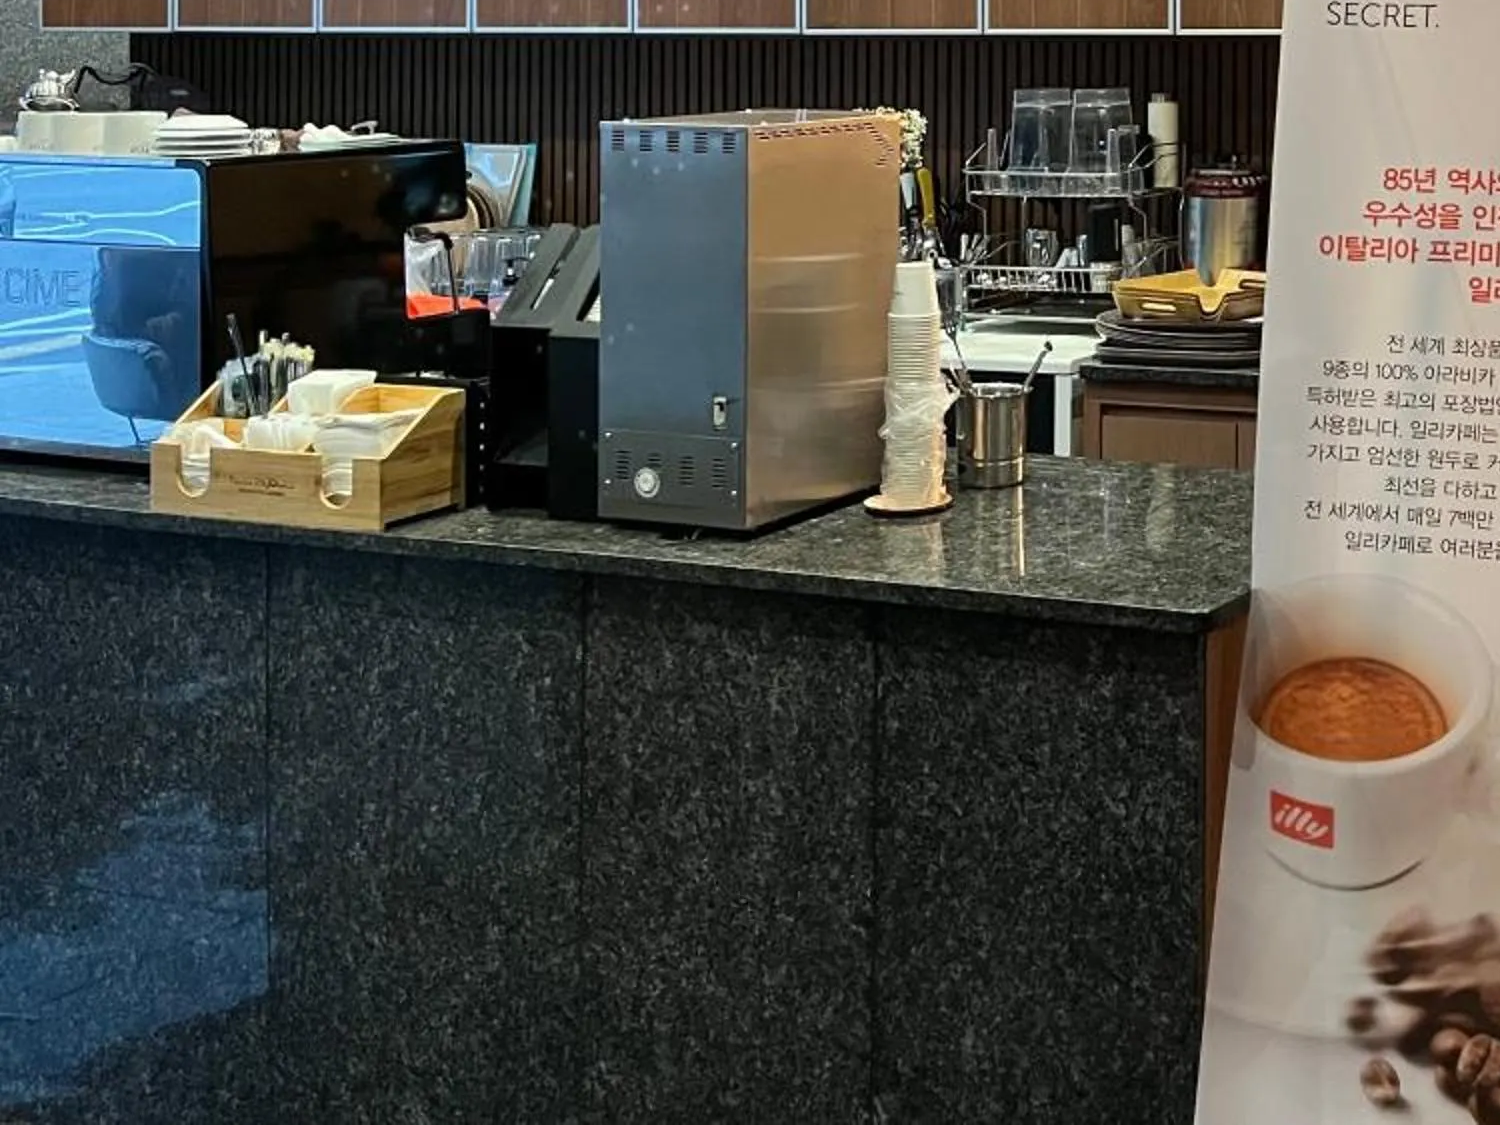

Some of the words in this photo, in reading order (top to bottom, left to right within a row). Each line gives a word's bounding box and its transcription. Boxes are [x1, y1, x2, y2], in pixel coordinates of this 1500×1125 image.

[1326, 2, 1440, 28] SECRET.
[1383, 169, 1436, 194] 85년
[1363, 202, 1462, 231] 우수성을
[1319, 235, 1419, 264] 이탈리아
[1387, 336, 1405, 354] 전
[1410, 337, 1445, 356] 세계
[1323, 360, 1369, 380] 9종의
[1375, 362, 1418, 381] 100%
[1424, 365, 1496, 388] 아라비카
[1307, 386, 1375, 409] 특허받은
[1383, 389, 1436, 412] 최고의
[1309, 415, 1402, 441] 사용합니다.
[1410, 419, 1497, 444] 일리카페는
[1307, 443, 1360, 463] 가지고
[1368, 446, 1420, 468] 엄선한
[1427, 449, 1479, 470] 원두로
[1384, 477, 1436, 496] 최선을
[1443, 480, 1497, 501] 다하고
[1304, 501, 1322, 520] 전
[1328, 502, 1399, 525] 세계에서
[1407, 507, 1442, 526] 매일
[1447, 509, 1494, 529] 7백만
[1345, 531, 1433, 554] 일리카페로
[1274, 803, 1328, 839] illy
